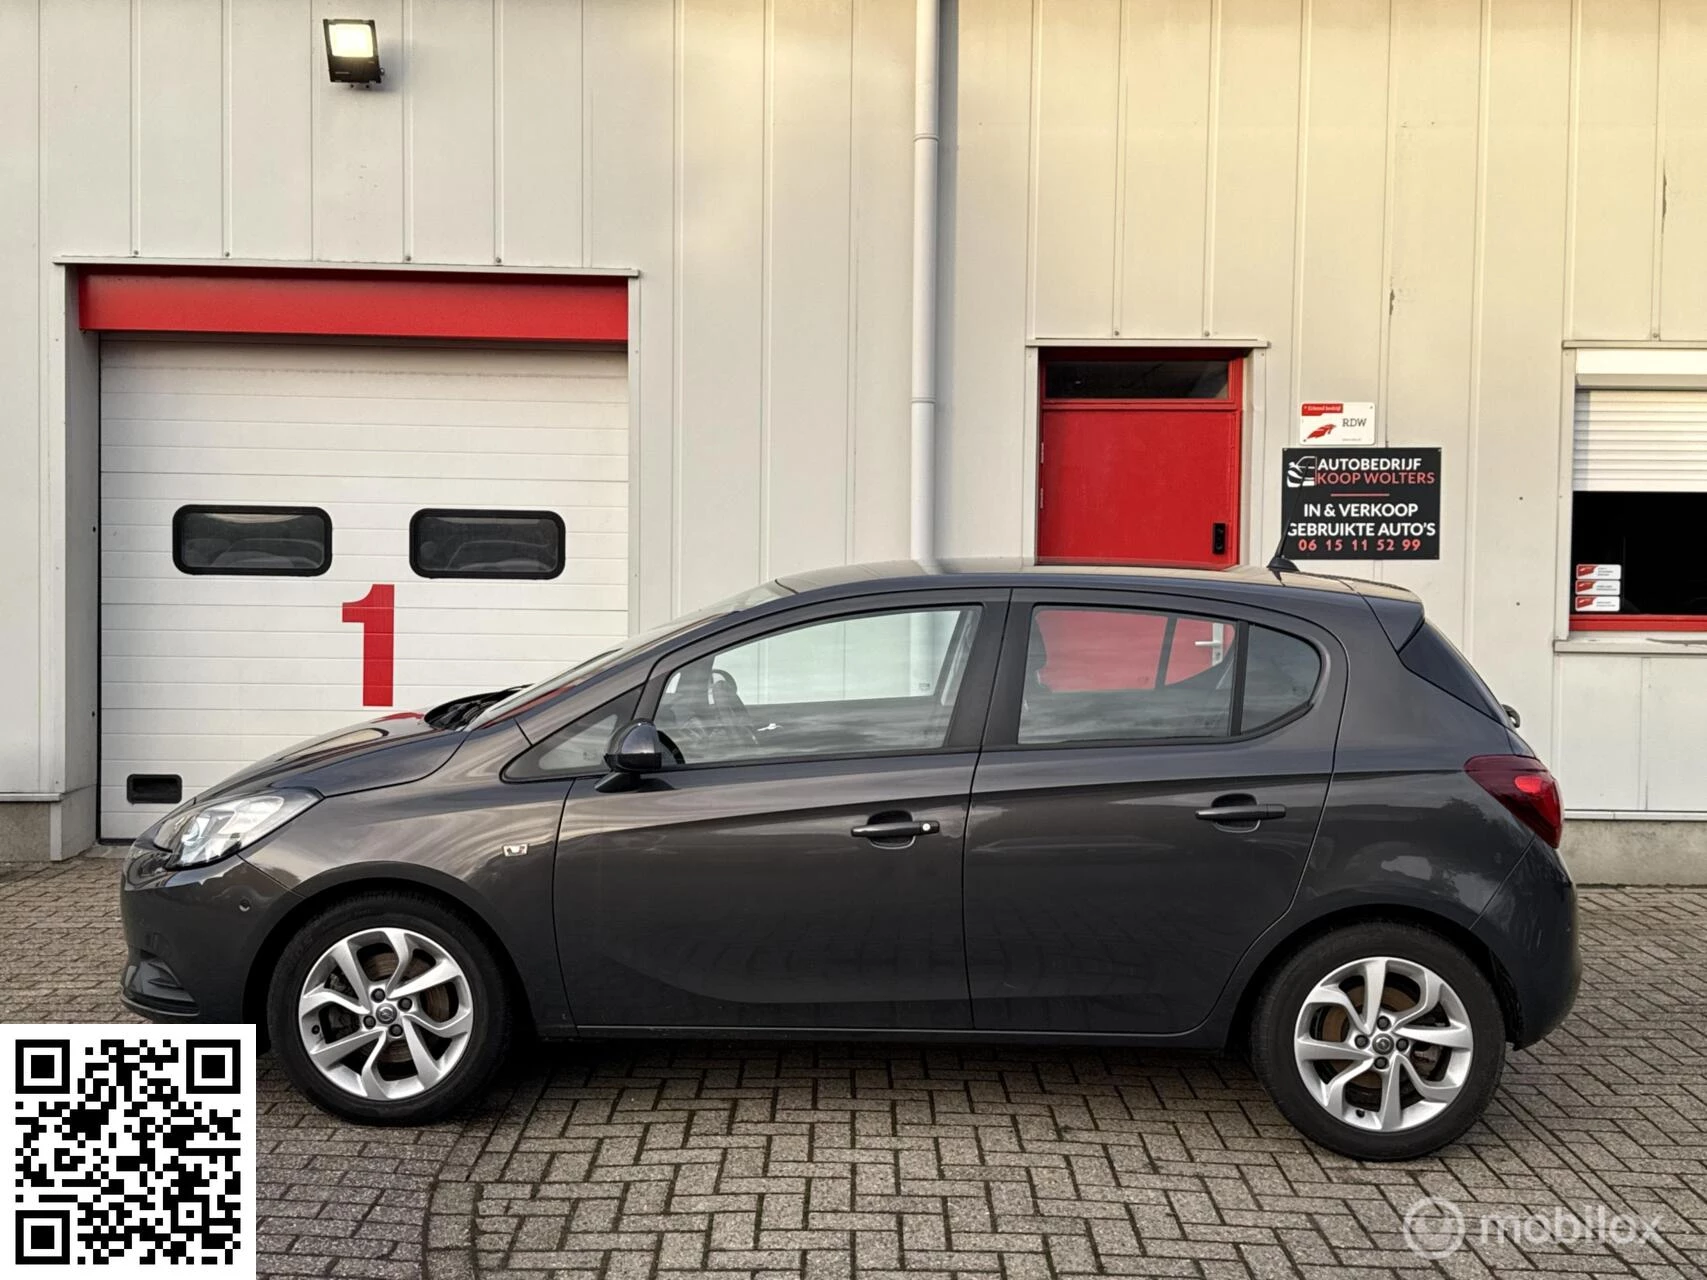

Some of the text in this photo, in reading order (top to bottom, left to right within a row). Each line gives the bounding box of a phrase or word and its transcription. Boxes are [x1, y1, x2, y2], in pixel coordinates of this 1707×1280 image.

[1342, 418, 1367, 427] RDW
[1317, 458, 1422, 471] AUTOBEDRIJF
[1317, 472, 1436, 485] KOOP WOLTERS
[1303, 503, 1419, 517] IN & VERKOOP
[1377, 522, 1436, 536] AUTO'S
[1298, 539, 1421, 551] 06 15 11 52 99
[342, 584, 394, 706] 1
